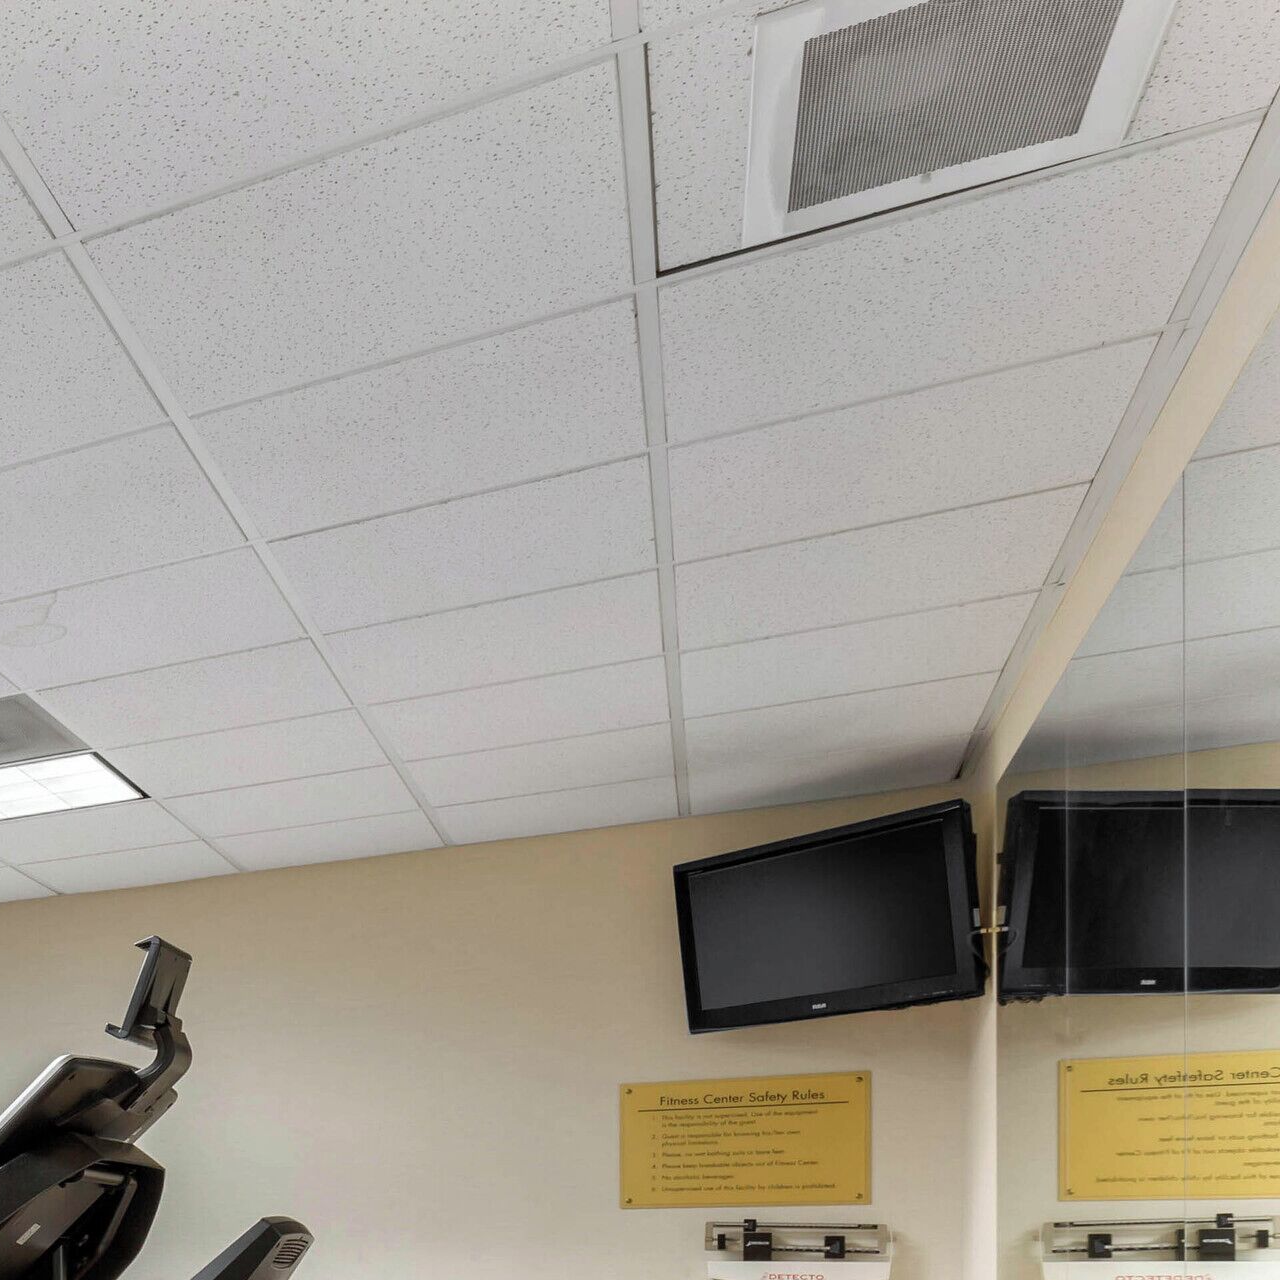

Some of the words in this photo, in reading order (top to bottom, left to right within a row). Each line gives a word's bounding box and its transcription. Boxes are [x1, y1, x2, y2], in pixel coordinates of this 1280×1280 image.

[660, 1096, 699, 1106] Fitness
[703, 1094, 745, 1105] Center
[749, 1091, 788, 1104] Safety
[792, 1089, 825, 1101] Rules
[768, 1273, 825, 1280] DETECTO
